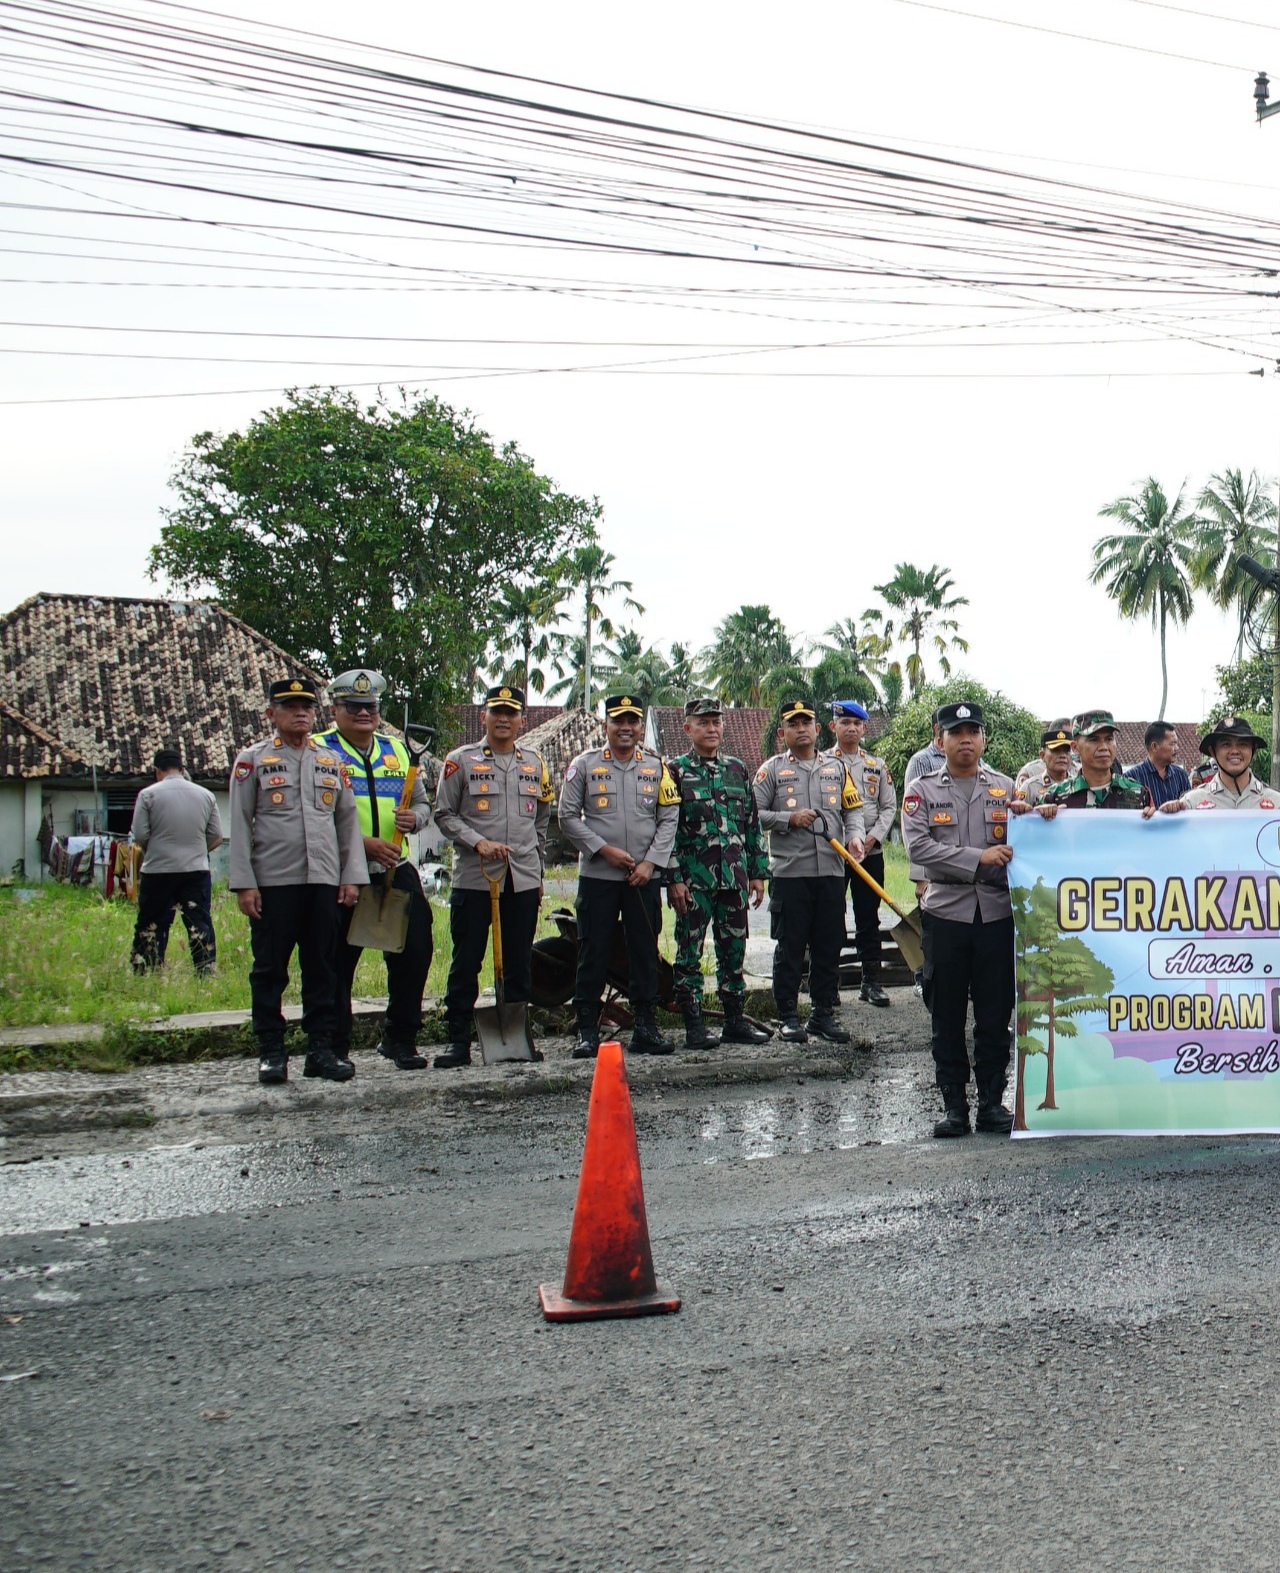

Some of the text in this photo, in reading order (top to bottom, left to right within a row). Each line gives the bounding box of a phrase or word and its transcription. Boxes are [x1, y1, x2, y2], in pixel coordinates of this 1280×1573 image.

[262, 765, 287, 775] AMRI
[315, 766, 338, 776] POLRI
[519, 775, 540, 783] POLRI
[1165, 941, 1253, 975] Aman
[1107, 993, 1267, 1032] PROGRAM
[1174, 1039, 1279, 1075] Bersih
